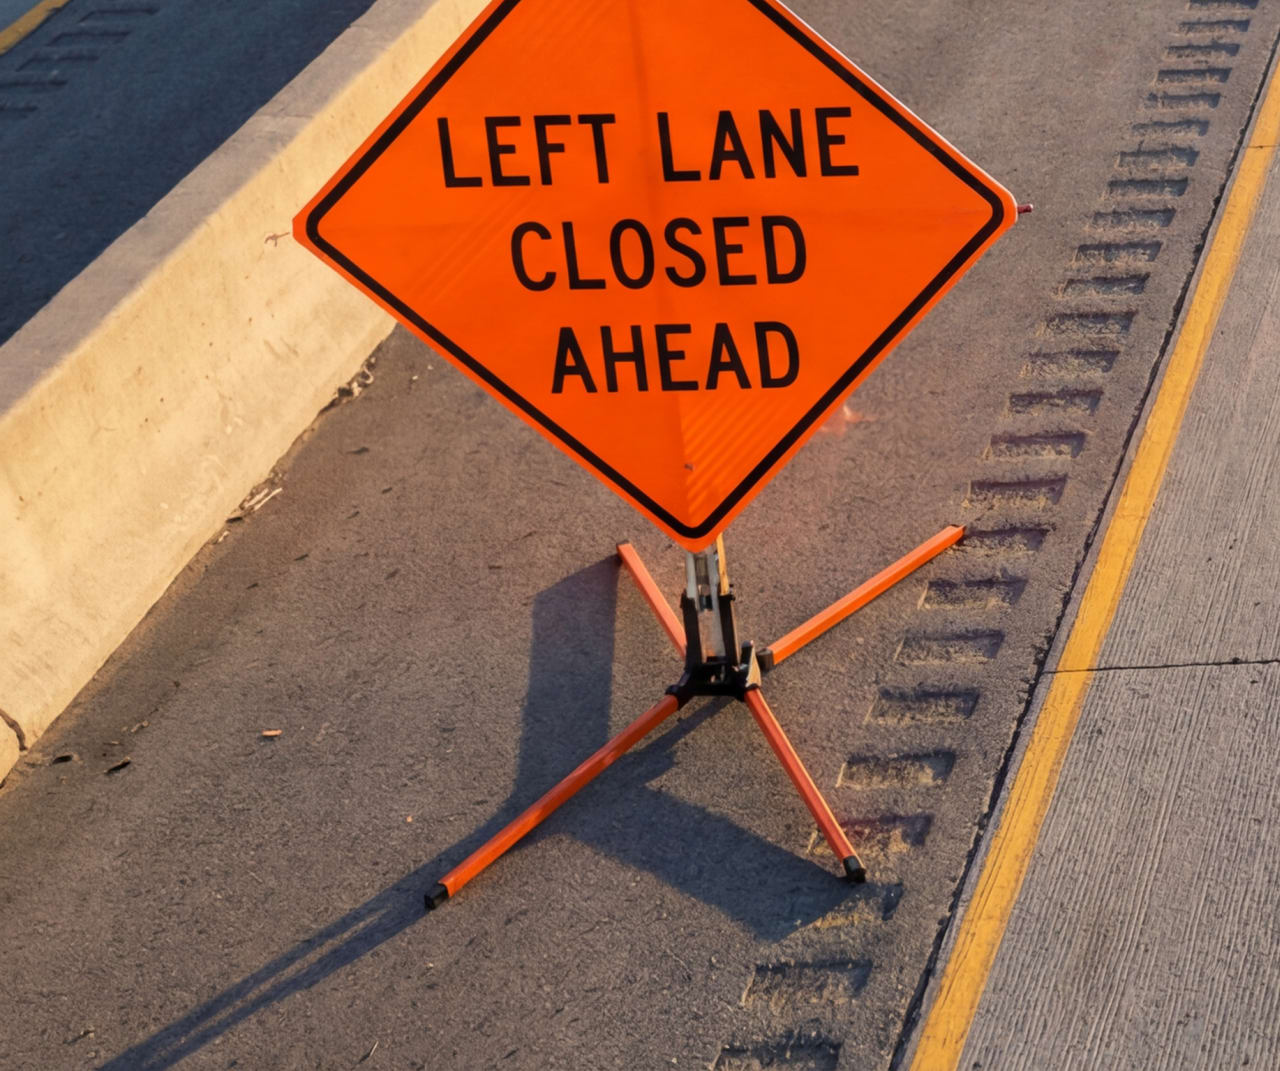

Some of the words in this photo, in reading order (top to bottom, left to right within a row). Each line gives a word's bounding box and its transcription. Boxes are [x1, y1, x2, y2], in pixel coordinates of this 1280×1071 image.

[437, 113, 616, 188] LEFT
[657, 106, 859, 183] LANE
[511, 215, 807, 292] CLOSED
[551, 321, 800, 394] AHEAD
